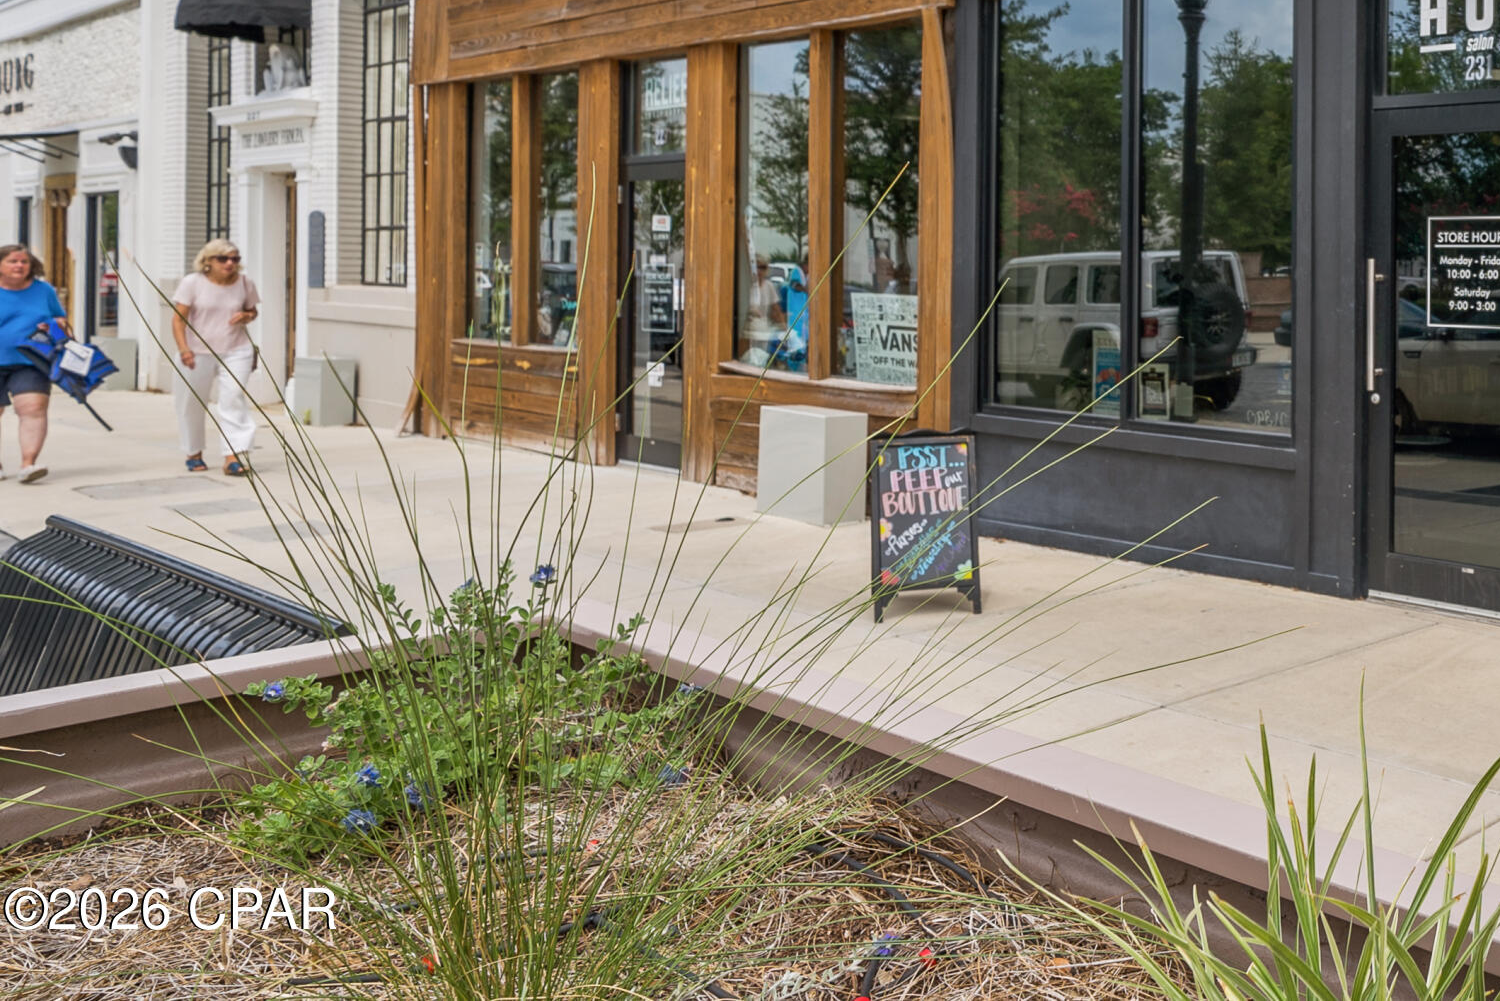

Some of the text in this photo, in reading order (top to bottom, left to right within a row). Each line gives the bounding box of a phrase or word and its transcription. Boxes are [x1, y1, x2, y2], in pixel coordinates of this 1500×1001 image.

[1466, 34, 1494, 52] salon
[1465, 54, 1494, 81] 231
[1437, 231, 1469, 243] STORE
[1439, 255, 1473, 268] Monday
[1447, 269, 1471, 279] 10:00
[1479, 269, 1499, 280] 6:00
[1454, 286, 1491, 299] Saturday
[1448, 300, 1469, 311] 9:00
[1476, 300, 1497, 311] 3:00
[890, 357, 906, 368] THE
[889, 466, 964, 493] PEEP our
[882, 485, 969, 518] BOUTIQUE
